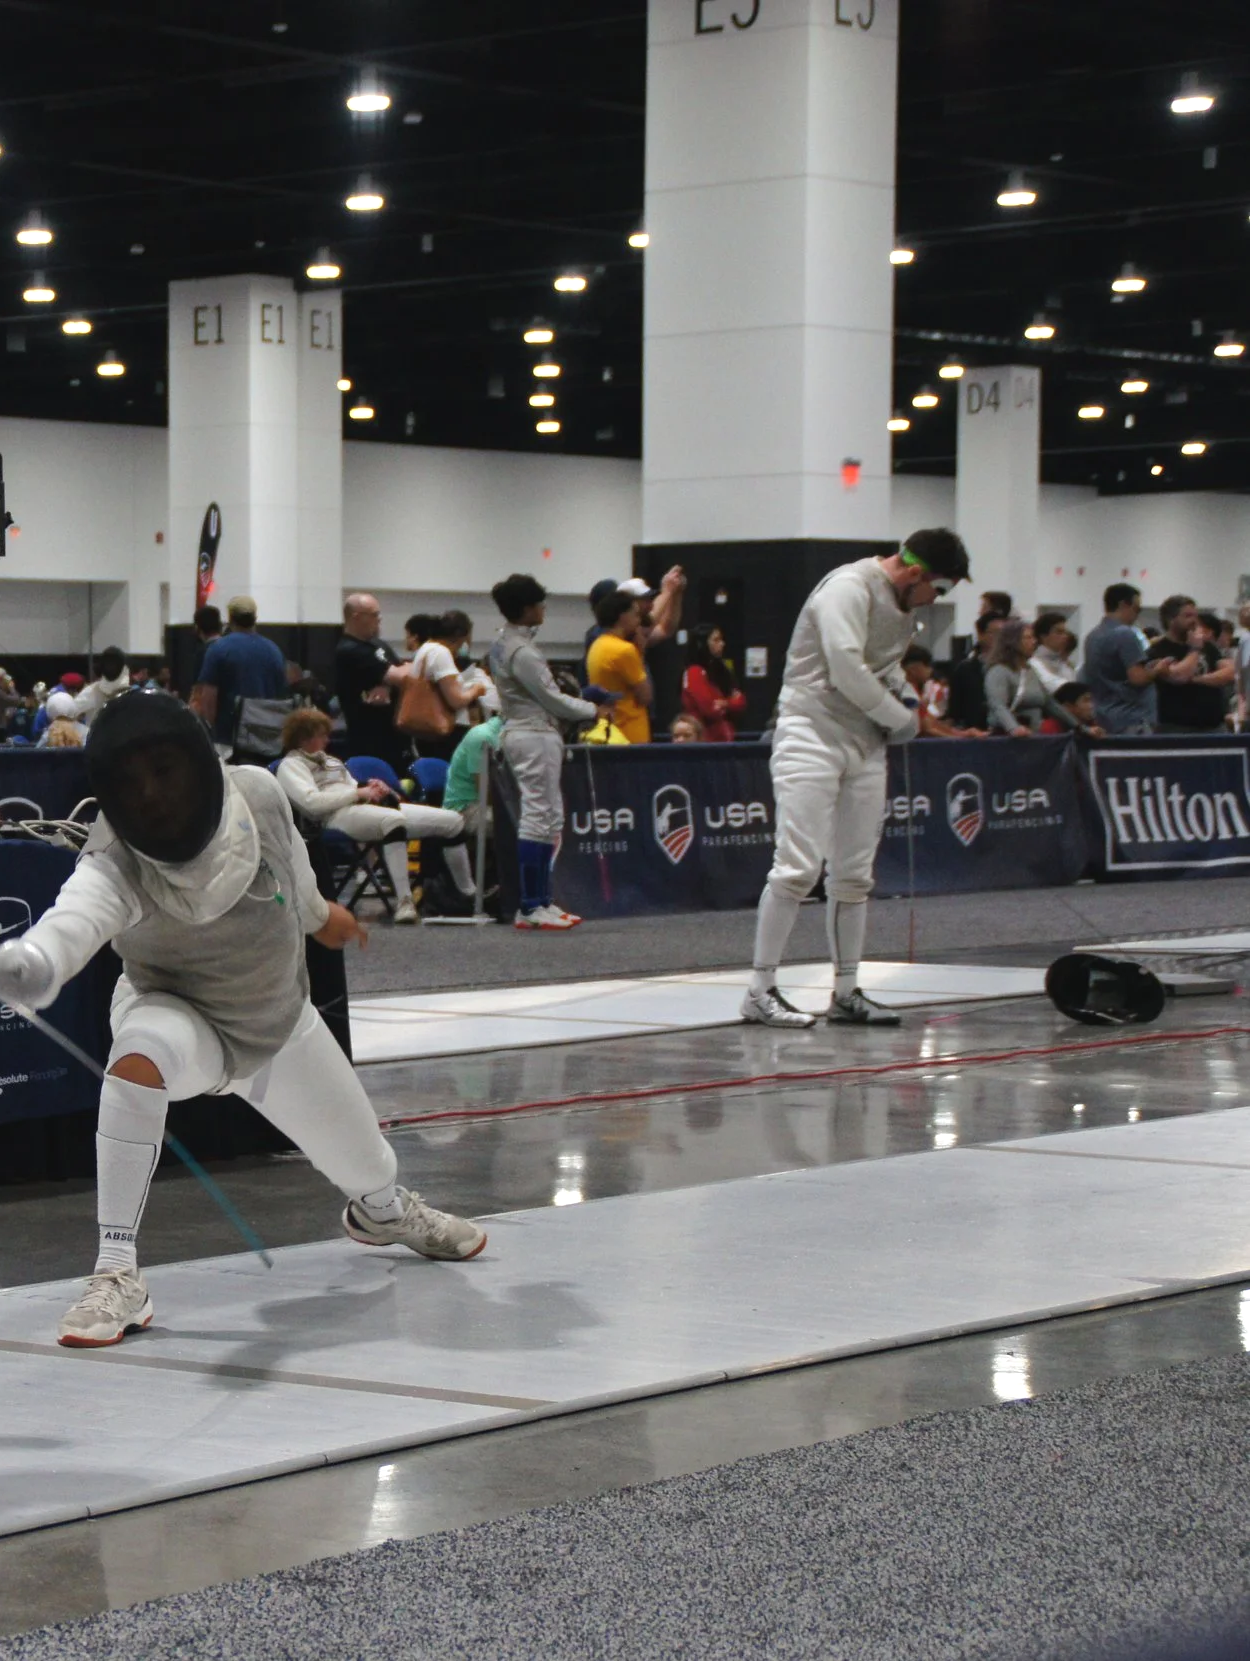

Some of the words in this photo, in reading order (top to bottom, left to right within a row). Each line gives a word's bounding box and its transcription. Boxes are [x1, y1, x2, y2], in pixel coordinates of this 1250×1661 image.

[194, 303, 225, 346] E1
[261, 303, 285, 345] E1
[310, 308, 334, 350] E1
[966, 380, 1001, 415] D4
[991, 787, 1051, 814] USA
[1105, 776, 1250, 844] Hilton
[571, 807, 635, 835] USA
[704, 801, 768, 829] USA
[701, 832, 775, 847] PARAFENCIN
[885, 825, 925, 838] ENCING
[578, 840, 629, 853] FENCING
[104, 1231, 136, 1243] ABSO
